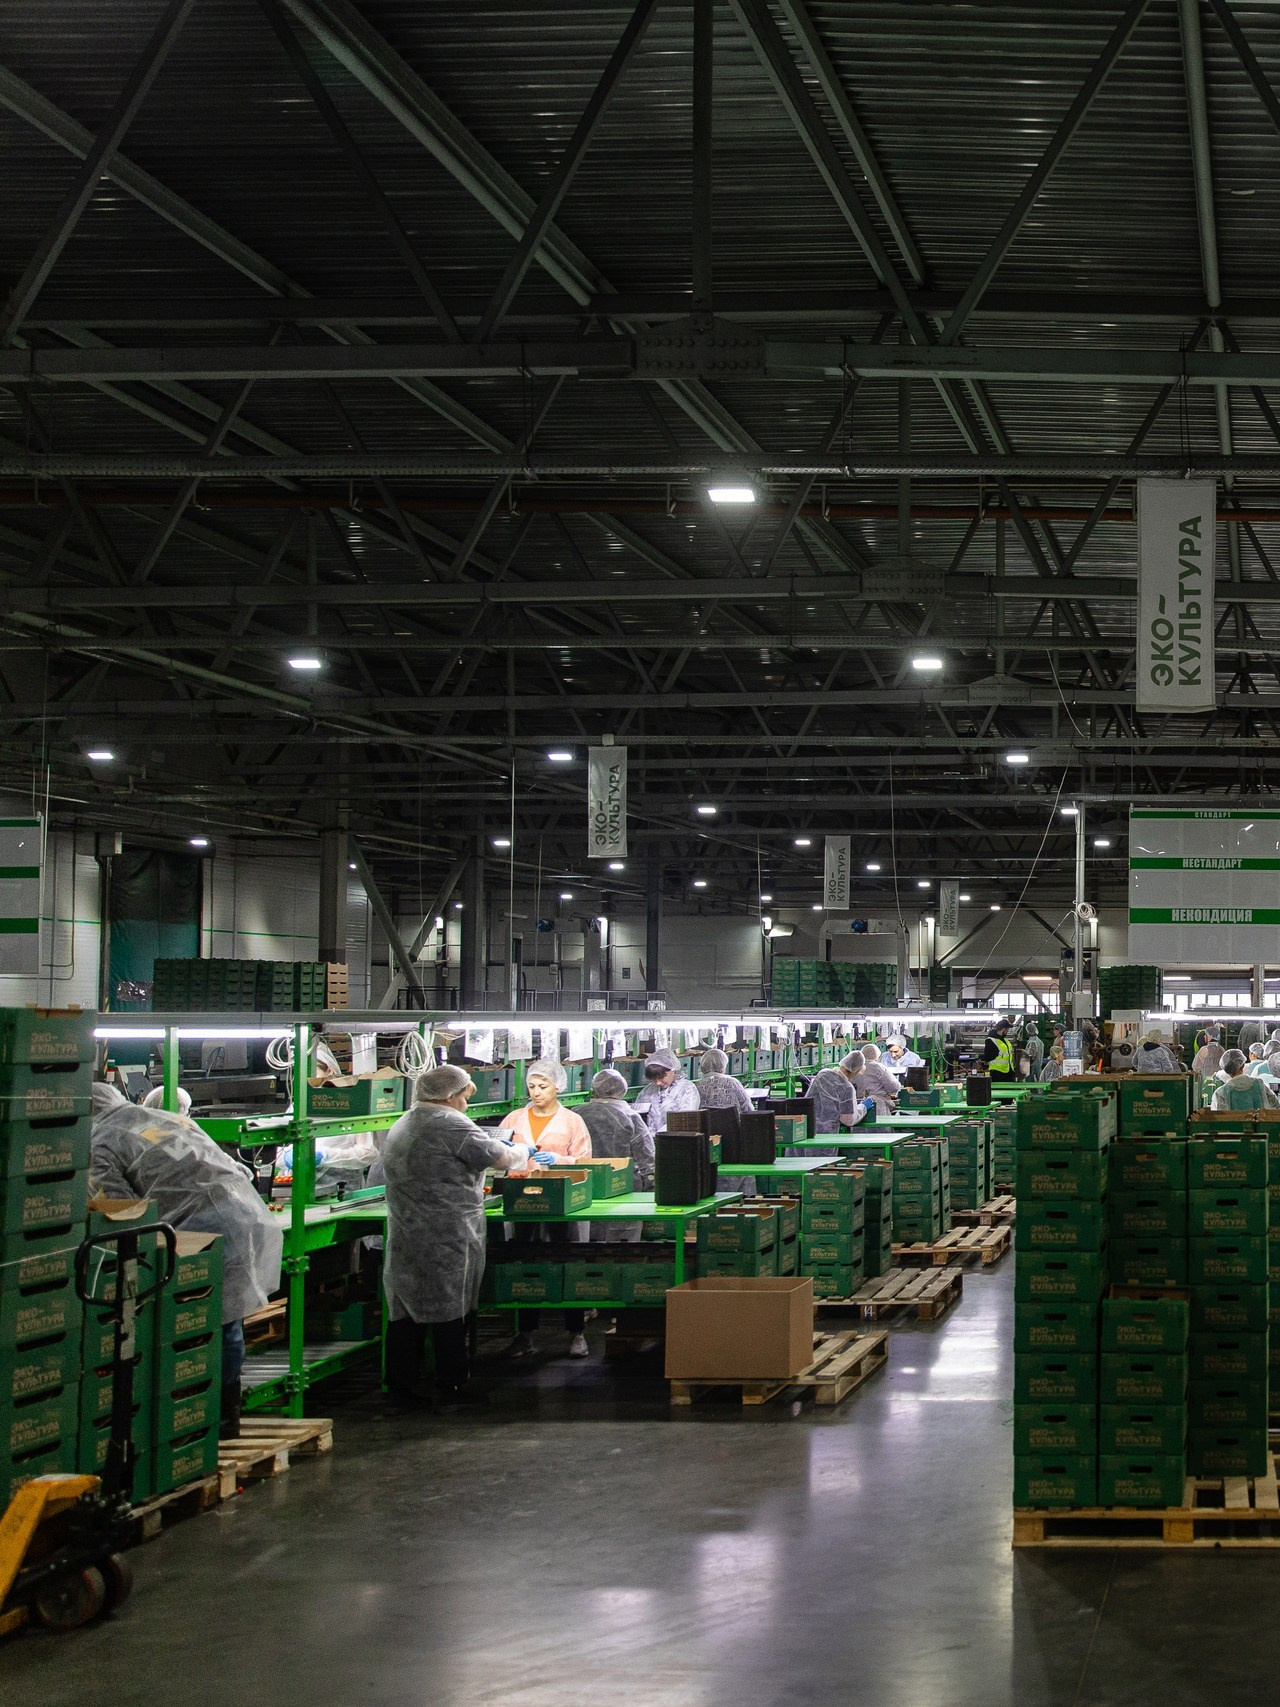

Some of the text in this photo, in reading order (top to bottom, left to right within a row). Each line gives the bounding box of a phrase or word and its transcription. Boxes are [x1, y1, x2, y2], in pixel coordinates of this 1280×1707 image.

[1178, 515, 1202, 686] КУЛЬТУРА
[608, 764, 620, 845] КУЛЬТУРА
[1182, 859, 1242, 869] НЕСТАНДАРТ
[837, 848, 846, 902] КУЛЬТУРА
[1171, 910, 1253, 923] НЕКОНДИЦИЯ
[31, 1043, 77, 1055] КУЛЬТУРА
[1032, 1132, 1078, 1140] КУЛЬТУРА
[25, 1154, 72, 1168] КУЛЬТУРА
[24, 1205, 71, 1220] КУЛЬТУРА
[1030, 1334, 1076, 1342] КУЛЬТУРА
[1117, 1334, 1163, 1342] КУЛЬТУРА
[1116, 1385, 1163, 1393] КУЛЬТУРА
[1029, 1436, 1076, 1444] КУЛЬТУРА
[1114, 1487, 1161, 1495] КУЛЬТУРА
